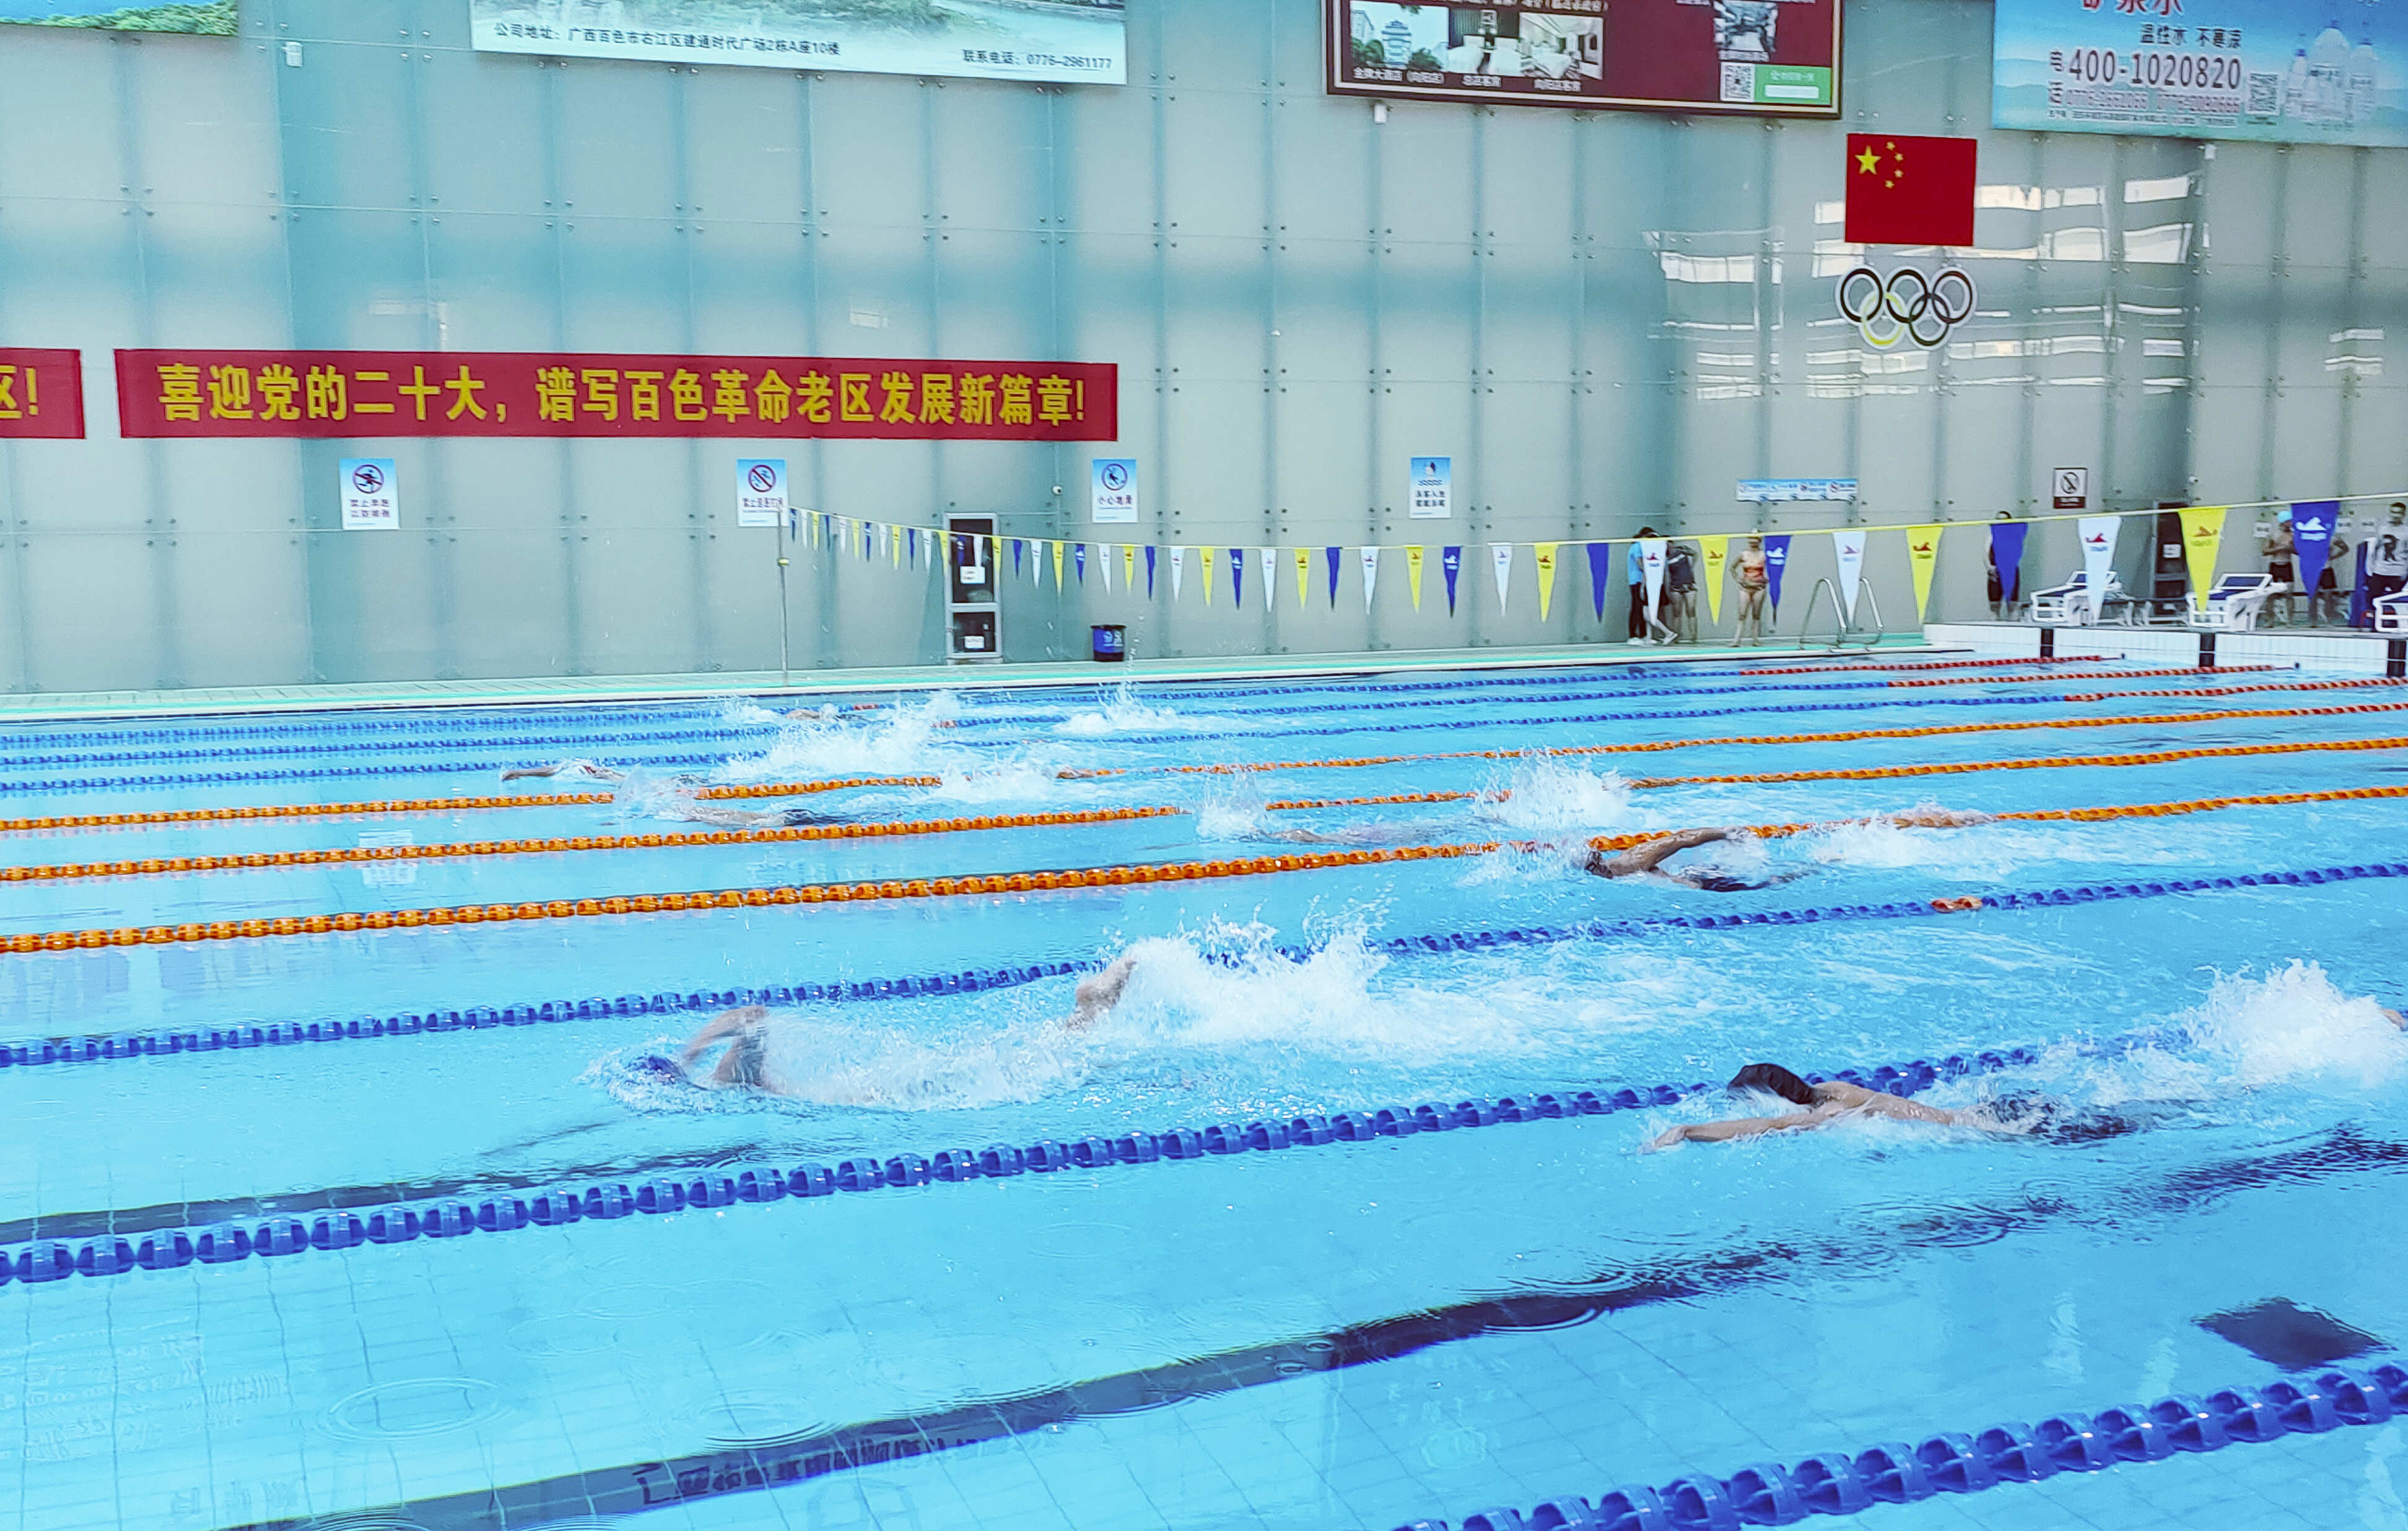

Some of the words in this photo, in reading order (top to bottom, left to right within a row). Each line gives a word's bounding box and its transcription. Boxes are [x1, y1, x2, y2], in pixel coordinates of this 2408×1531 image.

[2069, 48, 2241, 89] 400-1020820
[157, 363, 1086, 426] 喜迎党的二十大，谱写百色革命老区发展新篇章!
